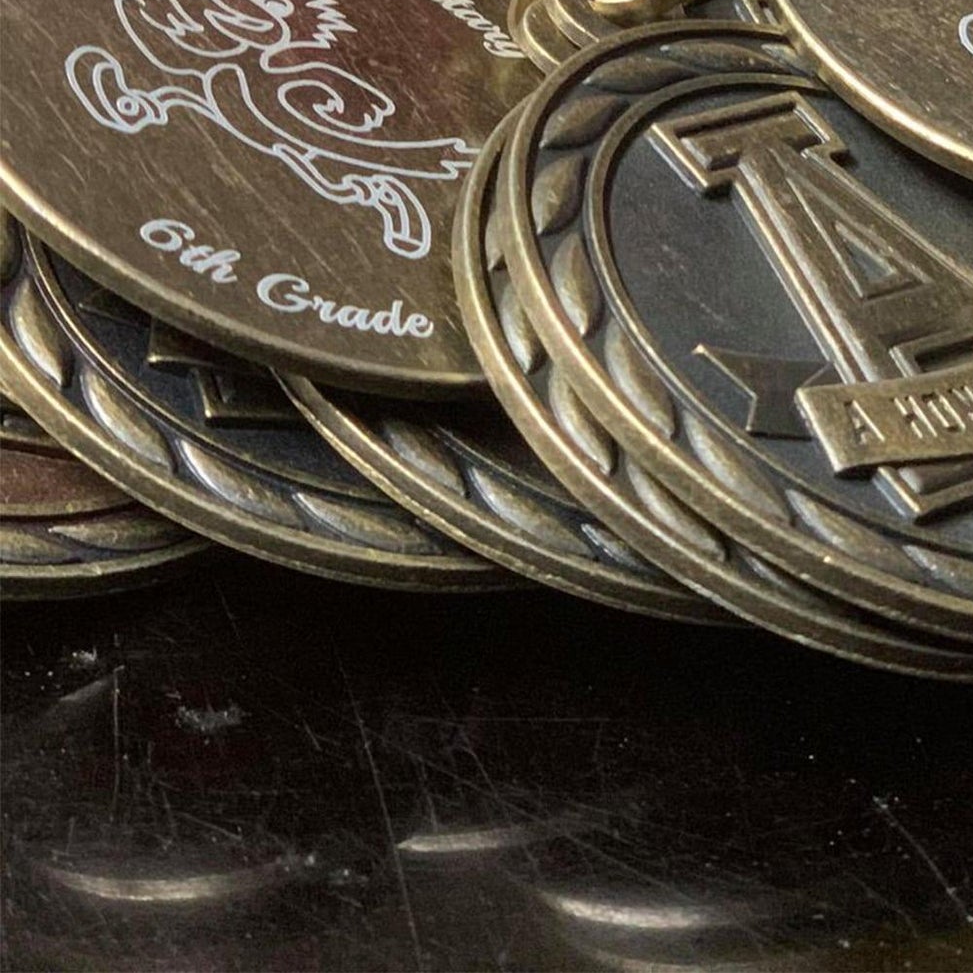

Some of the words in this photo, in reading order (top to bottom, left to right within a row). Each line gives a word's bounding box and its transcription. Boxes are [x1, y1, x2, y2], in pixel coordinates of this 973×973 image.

[139, 219, 242, 283] 6th
[256, 273, 434, 339] Grade
[843, 399, 886, 446] A
